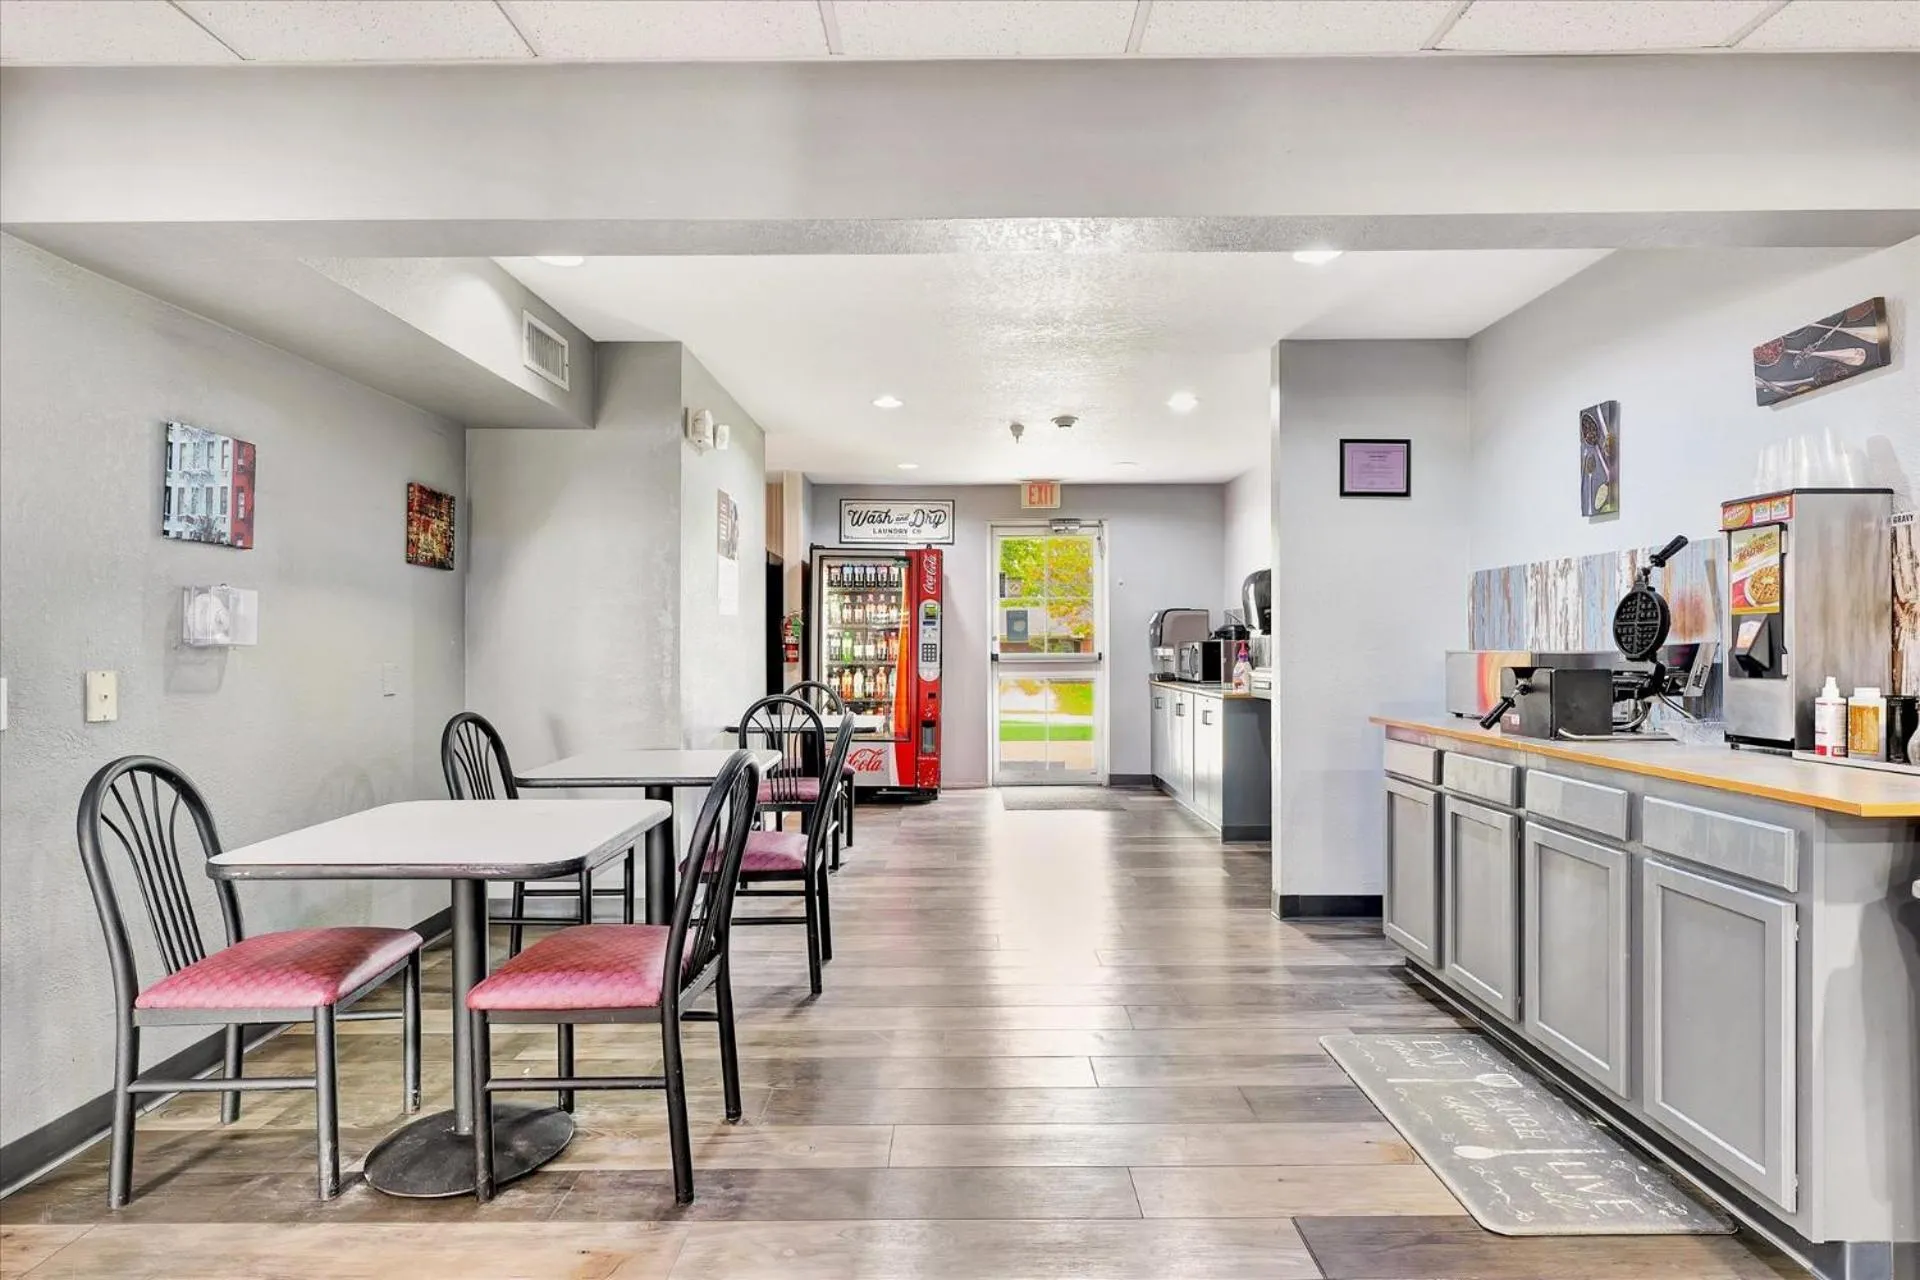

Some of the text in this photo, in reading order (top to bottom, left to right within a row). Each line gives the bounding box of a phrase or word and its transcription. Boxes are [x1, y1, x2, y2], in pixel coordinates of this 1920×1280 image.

[1029, 484, 1054, 504] EXIT
[848, 508, 947, 529] Wash and Dry
[1892, 514, 1914, 524] GRAVY
[872, 527, 908, 535] LAUNDRY
[1411, 1040, 1471, 1068] EAT
[1470, 1088, 1548, 1139] LAUGH
[1547, 1161, 1646, 1216] LIVE
